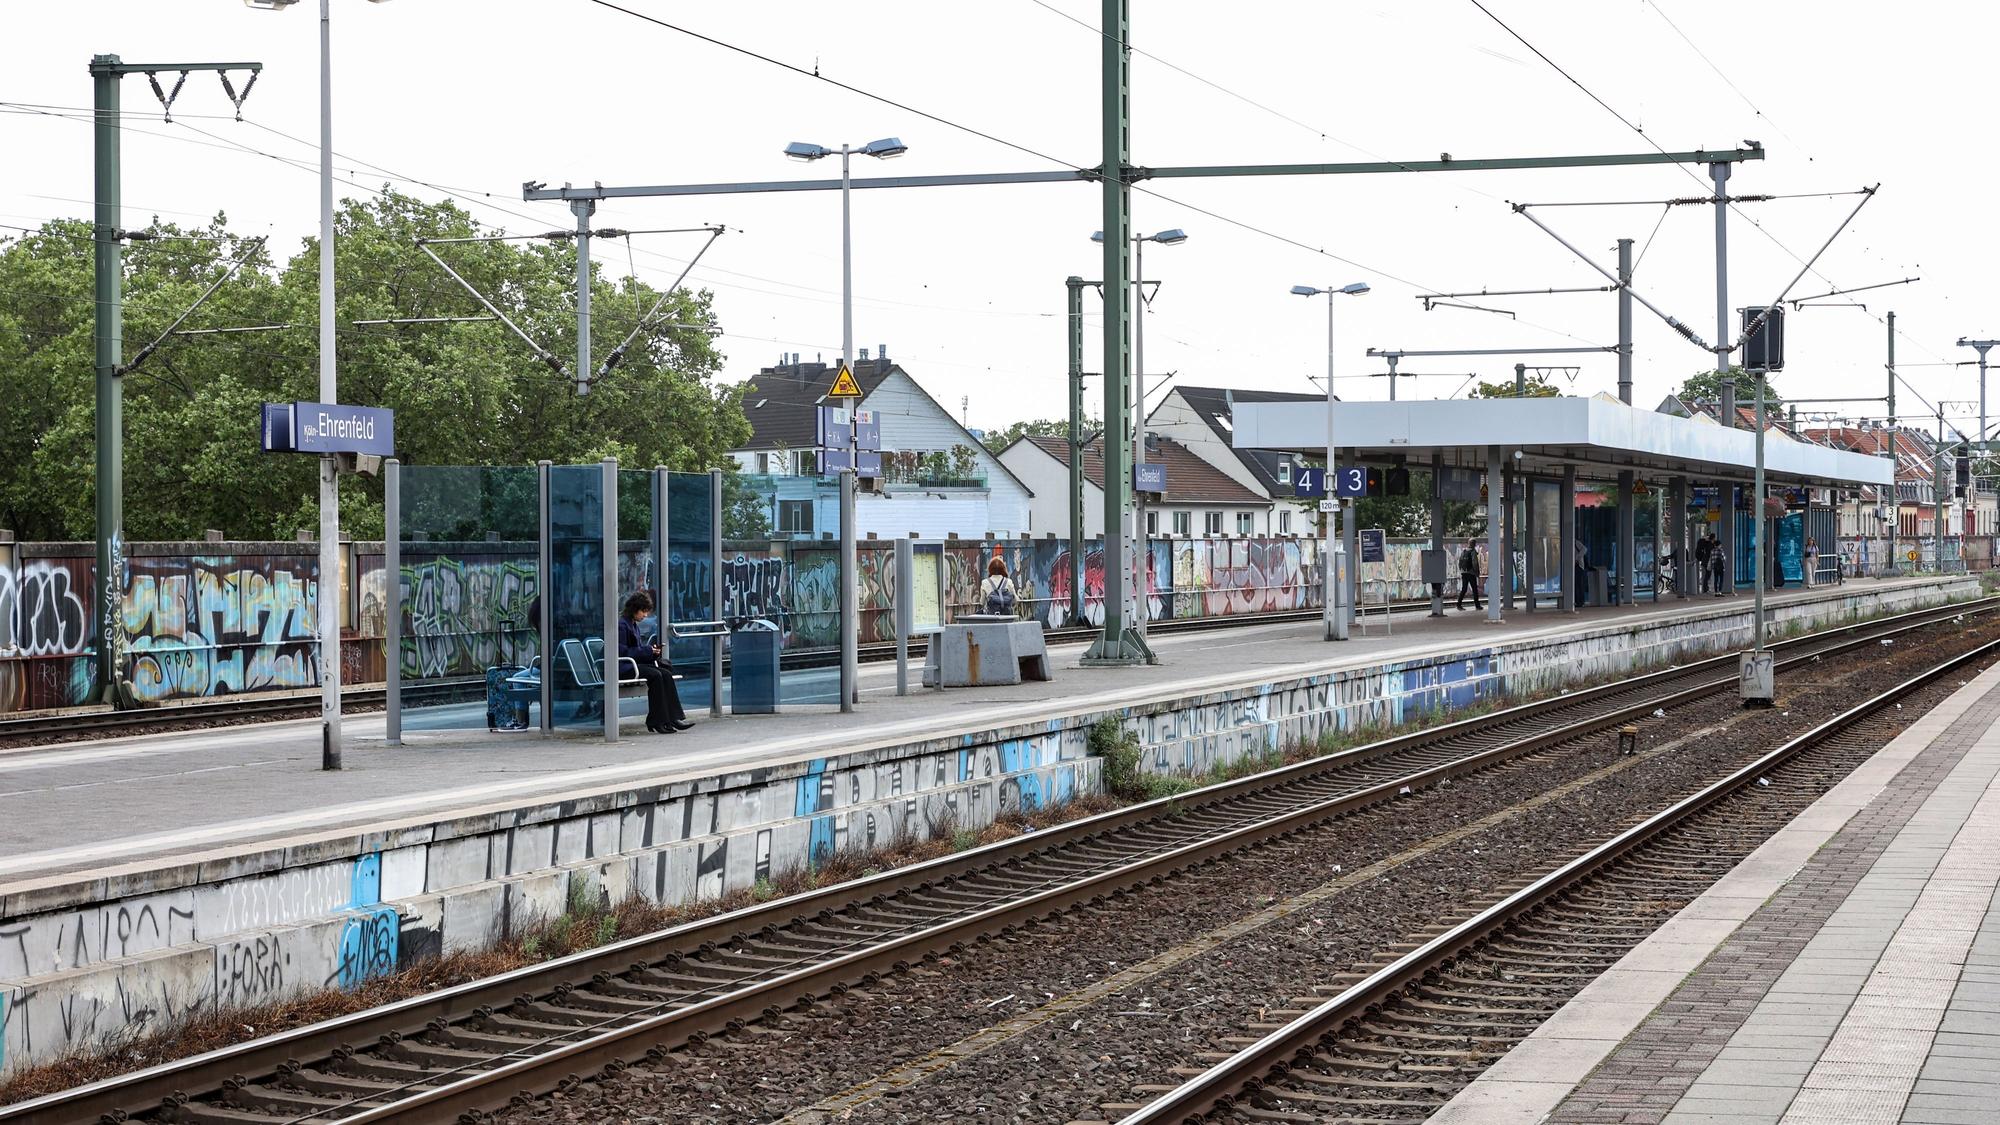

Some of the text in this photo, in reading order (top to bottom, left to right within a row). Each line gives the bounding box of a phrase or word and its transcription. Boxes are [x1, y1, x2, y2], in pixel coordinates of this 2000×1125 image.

[303, 412, 374, 440] Köln- Ehrenfeld
[1298, 470, 1313, 492] 4
[1347, 469, 1362, 491] 3
[1321, 502, 1332, 510] 120
[1888, 507, 1894, 516] 3
[1888, 516, 1894, 524] 6
[1846, 542, 1855, 553] 12
